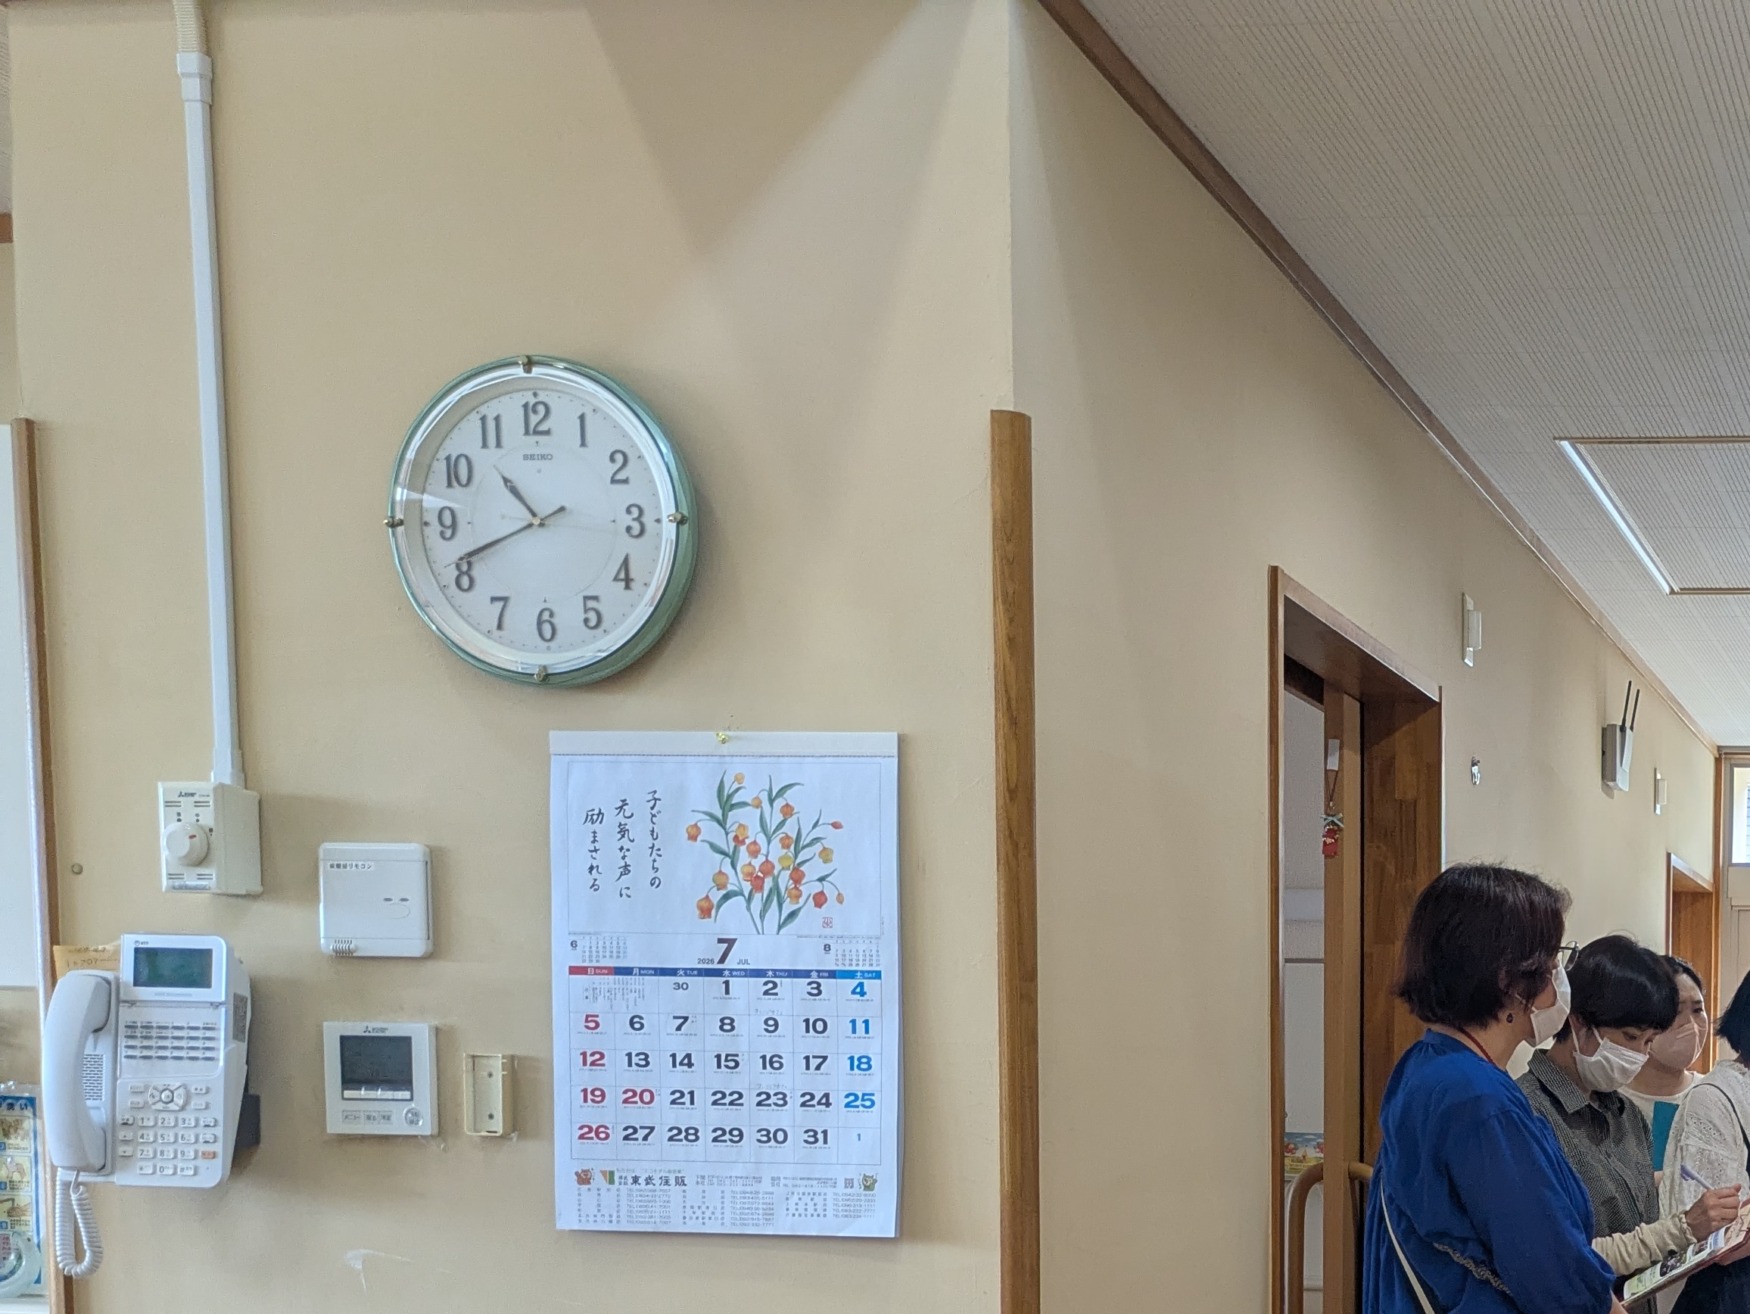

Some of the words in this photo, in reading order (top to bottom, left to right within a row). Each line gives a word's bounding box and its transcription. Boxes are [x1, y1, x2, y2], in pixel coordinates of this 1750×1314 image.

[521, 400, 552, 437] 12
[479, 413, 503, 450] 11
[577, 412, 588, 448] 1
[522, 453, 554, 461] SEIKO
[444, 453, 474, 489] 10
[608, 449, 630, 485] 2
[437, 505, 458, 542] 9
[625, 503, 646, 539] 3
[454, 556, 475, 593] 8
[612, 553, 635, 591] 4
[489, 596, 510, 631] 7
[582, 595, 603, 631] 5
[536, 607, 557, 643] 6
[614, 798, 635, 898] 元気な声に
[646, 789, 663, 889] 子どもたちの
[582, 807, 605, 892] 励まされる
[570, 940, 578, 948] 6
[716, 937, 738, 965] 7
[823, 943, 831, 952] 8
[587, 967, 594, 975] 日
[736, 958, 751, 966] JUL
[632, 967, 639, 976] 月
[676, 968, 686, 976] 火
[722, 969, 731, 977] 水
[766, 969, 775, 977] 木
[809, 970, 819, 978] 金
[854, 971, 864, 979] 土
[672, 981, 689, 991] 30
[722, 979, 731, 996] 1
[762, 979, 779, 997] 2
[806, 980, 823, 998] 3
[850, 981, 867, 998] 4
[583, 1013, 601, 1031] 5
[628, 1014, 645, 1032] 6
[672, 1015, 690, 1032] 7
[718, 1016, 736, 1033] 8
[763, 1016, 780, 1034] 9
[802, 1017, 828, 1035] 10
[849, 1018, 870, 1035] 11
[579, 1050, 606, 1067] 12
[624, 1051, 651, 1069] 13
[669, 1052, 695, 1069] 14
[713, 1053, 740, 1071] 15
[759, 1053, 784, 1071] 16
[802, 1054, 829, 1072] 17
[847, 1055, 873, 1072] 18
[580, 1087, 607, 1105] 19
[621, 1088, 655, 1106] 20
[669, 1089, 695, 1106] 21
[710, 1090, 745, 1107] 22
[755, 1090, 788, 1108] 23
[799, 1091, 833, 1109] 24
[843, 1092, 876, 1109] 25
[577, 1124, 611, 1142] 26
[622, 1124, 656, 1142] 27
[666, 1125, 700, 1143] 28
[711, 1126, 744, 1144] 29
[755, 1127, 789, 1145] 30
[802, 1128, 829, 1145] 31
[856, 1133, 862, 1142] 1
